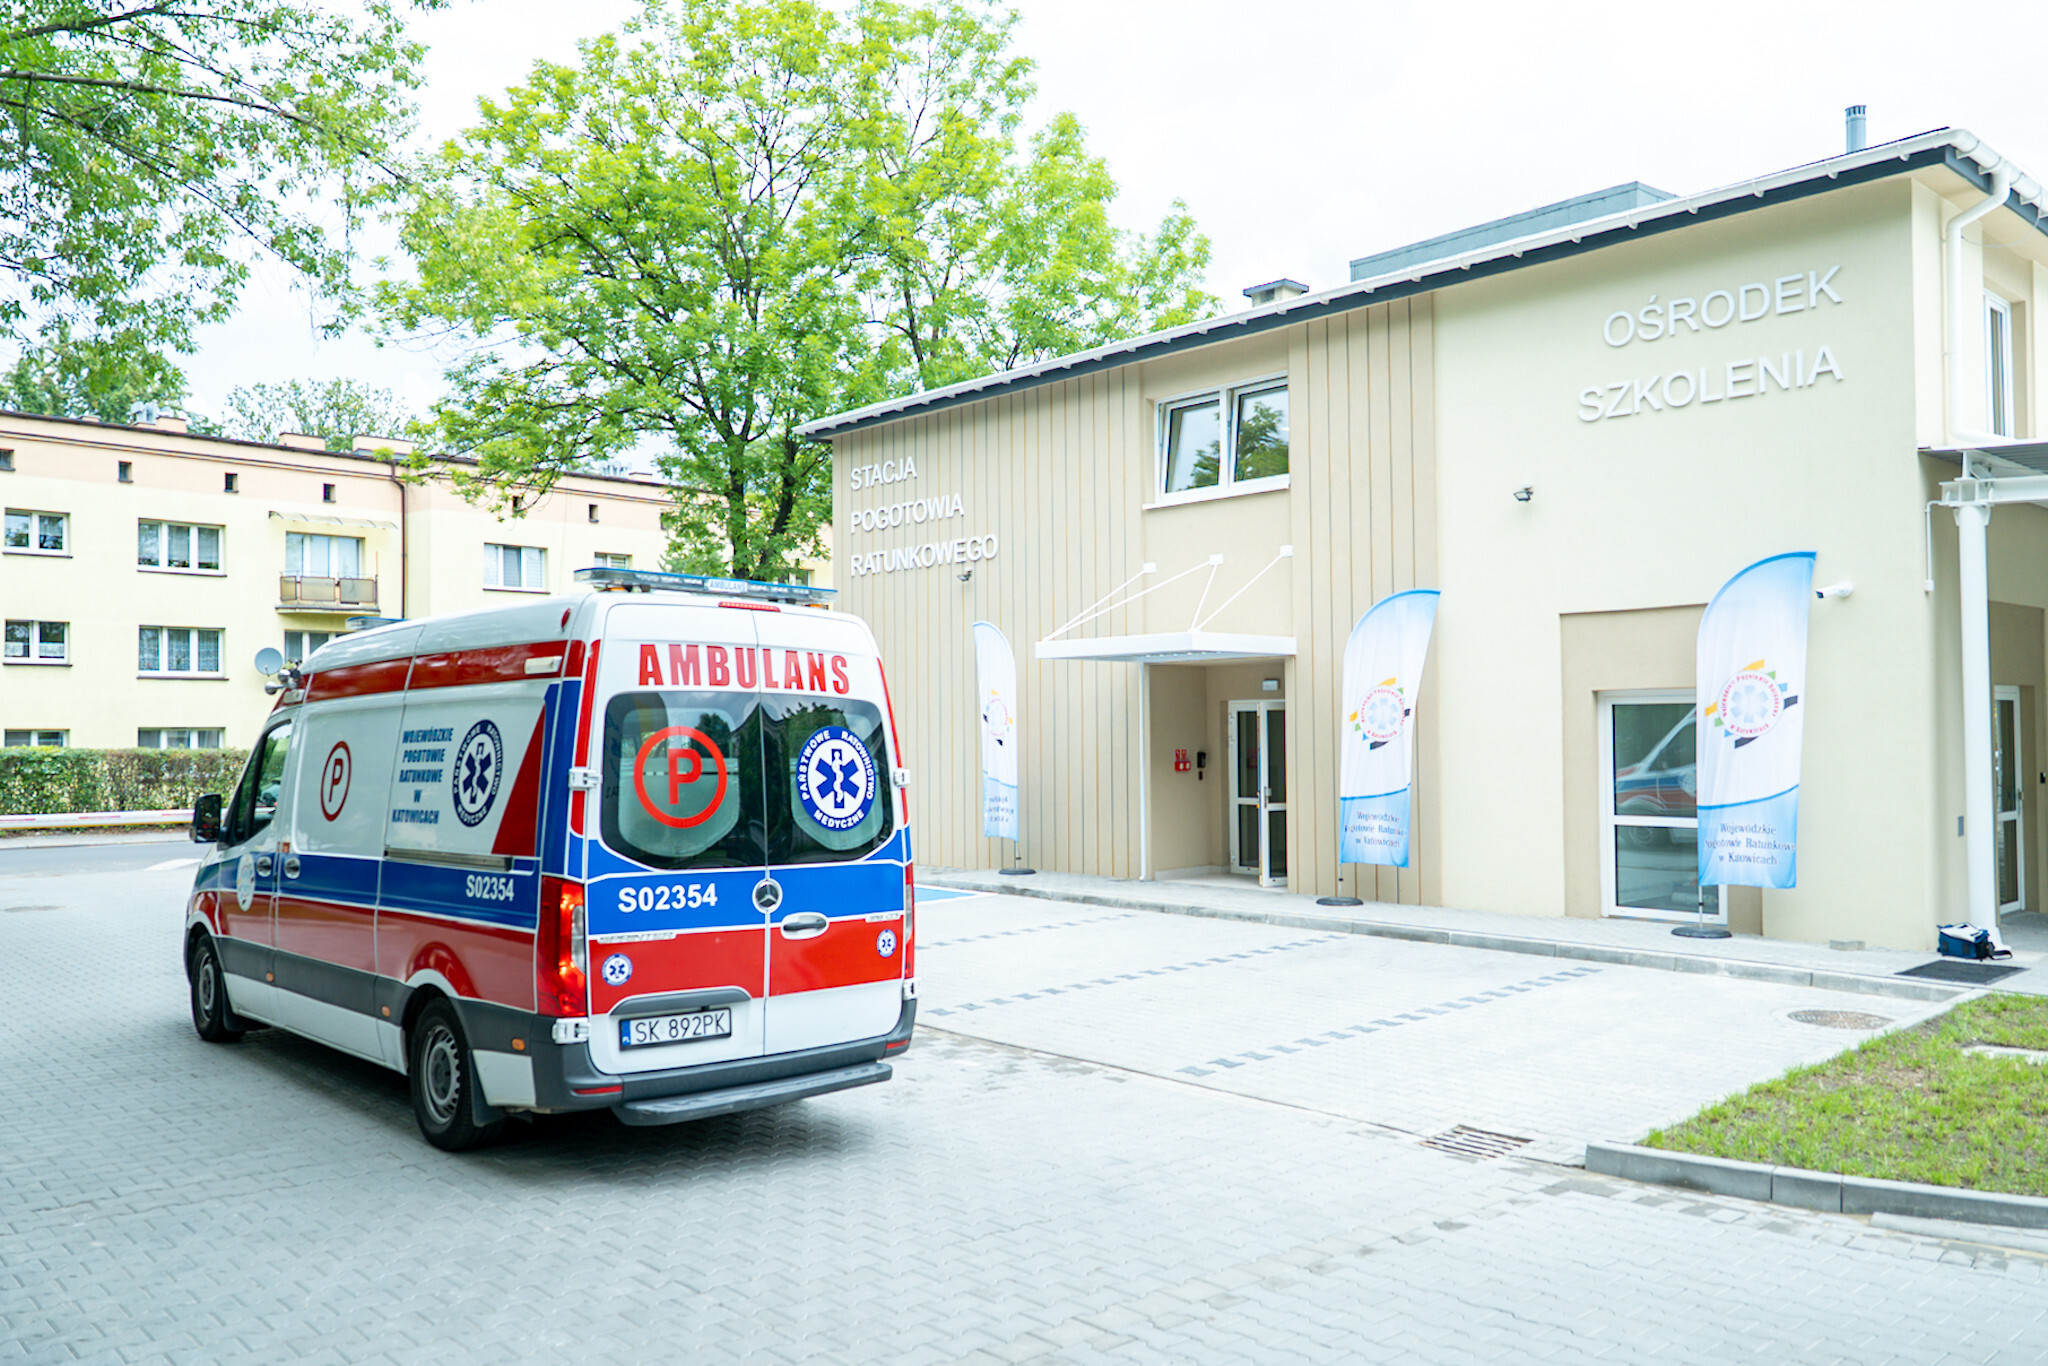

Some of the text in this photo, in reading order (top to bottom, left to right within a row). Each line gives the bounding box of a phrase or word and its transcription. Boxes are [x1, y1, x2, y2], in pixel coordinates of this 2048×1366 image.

[1603, 264, 1843, 348] OŚRODEK
[1577, 345, 1844, 423] SZKOLENIA
[851, 456, 917, 491] STACJA
[850, 492, 965, 534] POGOTOWIA
[850, 534, 999, 577] RATUNKOWEGO
[638, 643, 850, 695] AMBULANS
[402, 726, 453, 743] WOJEWÓDZKIE
[403, 748, 445, 763] POGOTOWIE
[798, 730, 875, 800] PAŃSTWOWE RATOWNICTWO
[329, 757, 344, 803] P
[399, 769, 443, 783] RATUNKOWE
[668, 748, 703, 805] P
[413, 789, 422, 803] W
[392, 809, 439, 824] KATOWICACH
[813, 809, 865, 829] MEDYCZNE
[466, 874, 514, 902] S02354
[617, 883, 718, 913] S02354
[635, 1012, 725, 1042] SK 892PK
